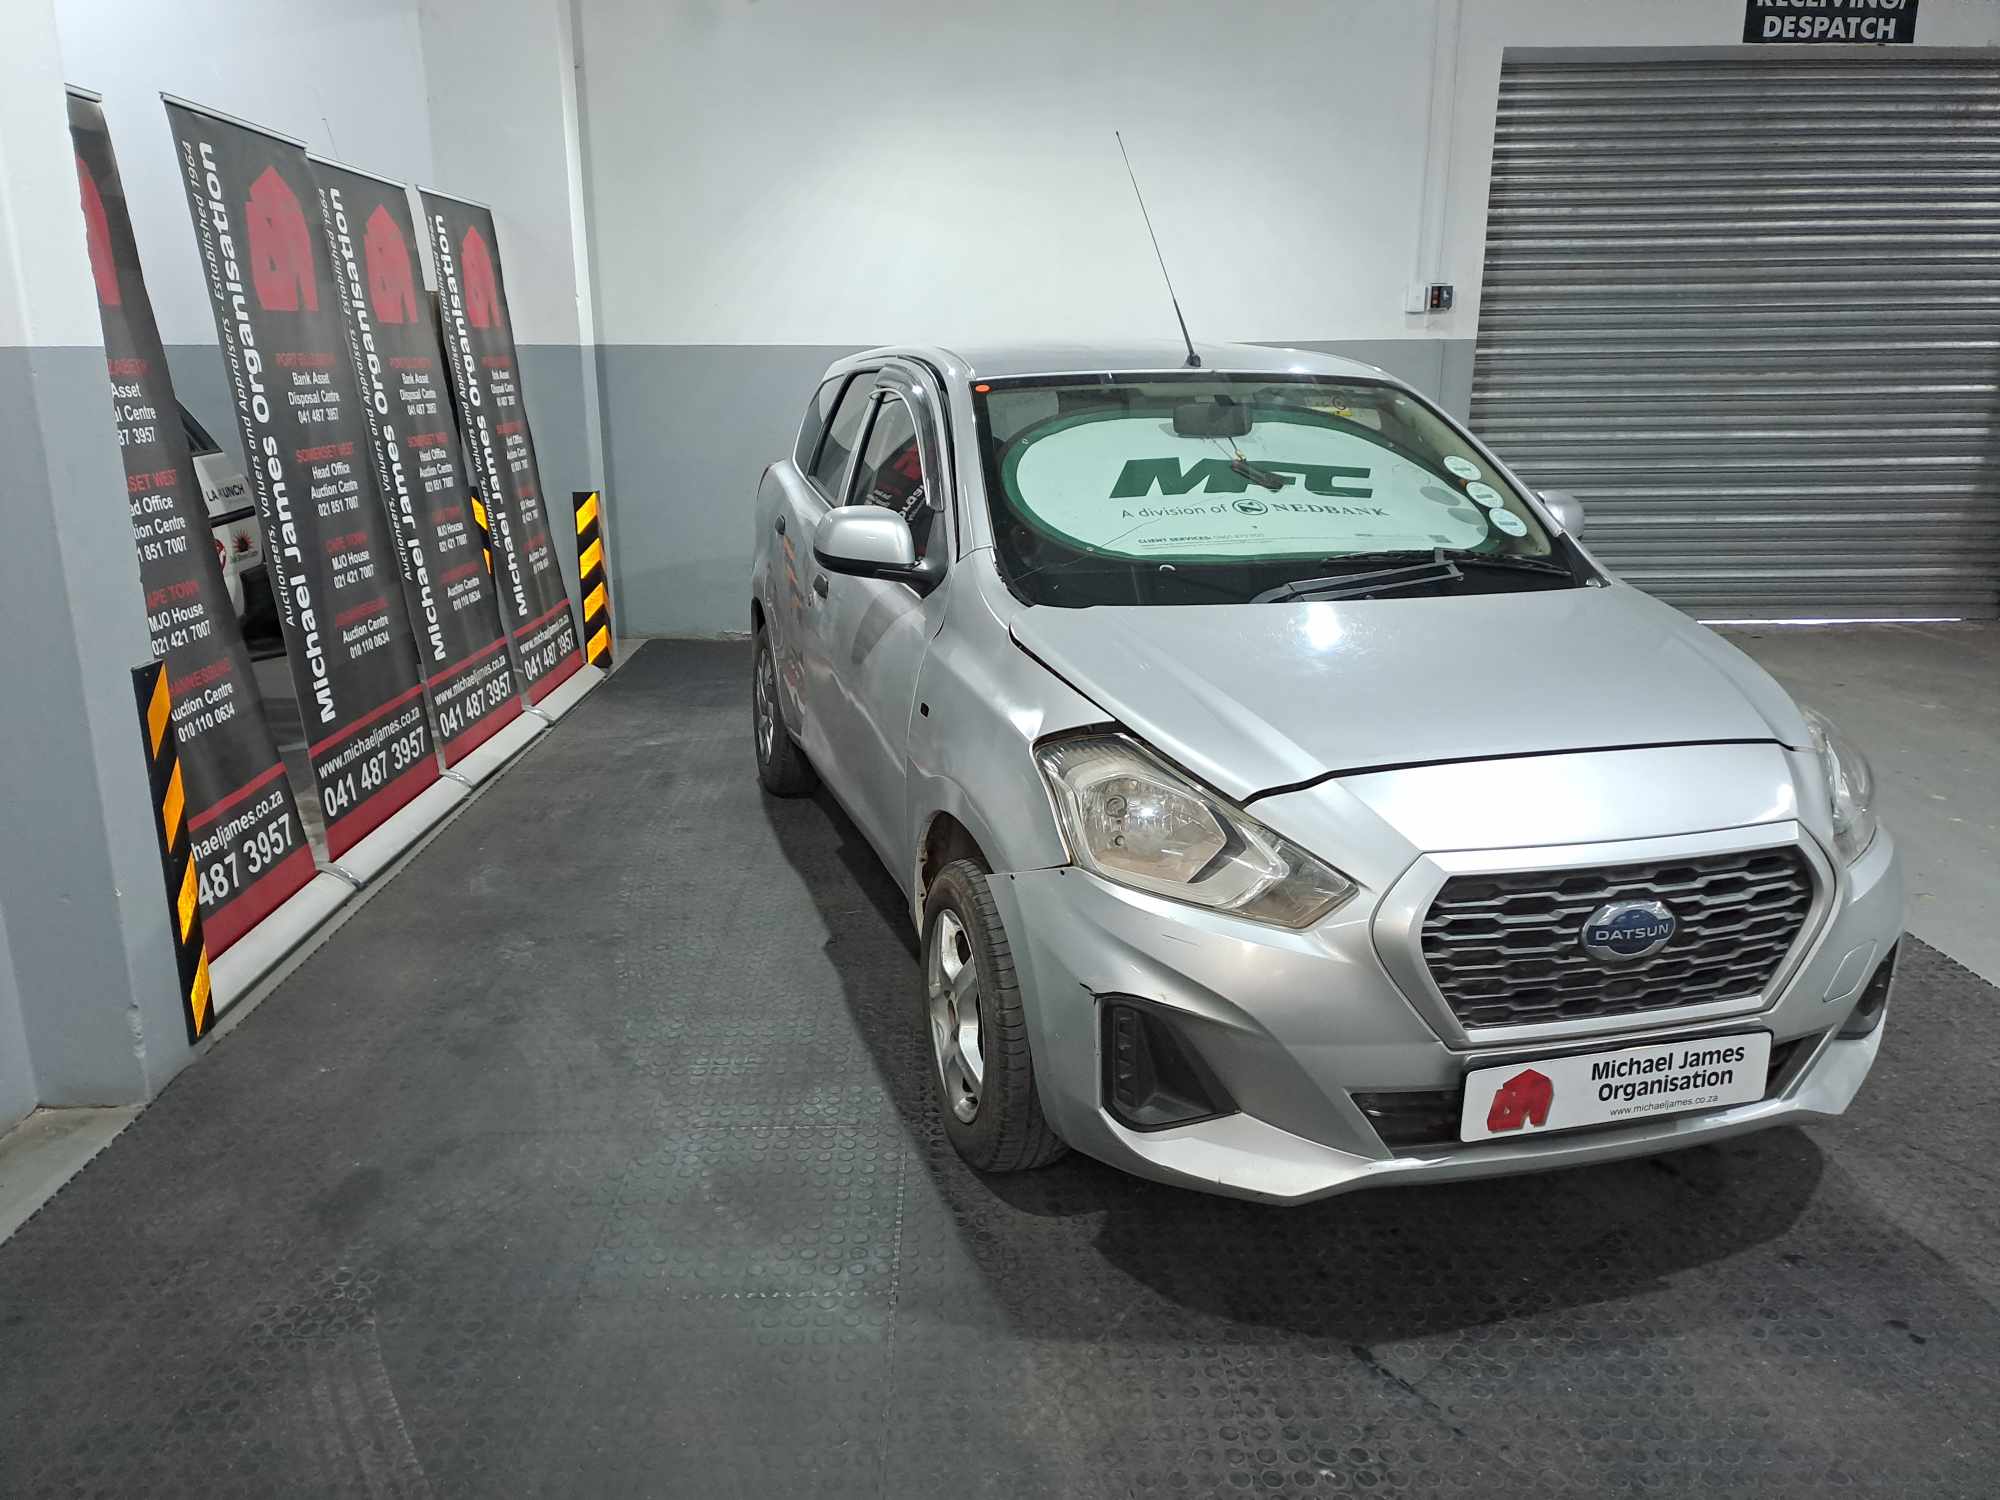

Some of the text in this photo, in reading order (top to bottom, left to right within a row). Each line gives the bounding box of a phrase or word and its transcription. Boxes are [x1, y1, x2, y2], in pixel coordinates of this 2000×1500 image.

[1763, 15, 1897, 39] DESPATCH
[182, 140, 200, 188] 1964
[192, 192, 224, 301] Established
[330, 188, 388, 415] Organisation
[435, 215, 480, 407] Organisation
[223, 318, 249, 412] Appraisers
[292, 371, 312, 386] Bank
[111, 382, 142, 398] Asset
[287, 389, 320, 407] Disposal
[123, 404, 157, 421] Centre
[132, 426, 155, 444] 3957
[199, 142, 336, 724] Michael James Organisation
[242, 415, 256, 449] and
[311, 464, 331, 480] Head
[383, 425, 416, 529] James
[477, 416, 503, 505] James
[252, 455, 271, 518] Valuers
[311, 483, 338, 499] Auction
[142, 495, 174, 513] Office
[1122, 503, 1391, 519] A division of NEDBANK
[154, 515, 186, 534] Centre
[143, 541, 164, 561] 851
[164, 535, 187, 555] 7007
[496, 512, 527, 616] Michael
[407, 539, 446, 660] Michael
[148, 603, 204, 633] MJO House
[342, 624, 368, 644] Auction
[151, 620, 212, 656] 021 421 7007
[524, 652, 543, 681] 041
[543, 641, 557, 668] 487
[203, 682, 234, 705] Centre
[440, 671, 512, 738] 041 487 3957
[178, 701, 236, 743] 010 110 0634
[318, 706, 420, 779] www.michaeljames.co.za
[324, 725, 425, 817] 041 487 3957
[198, 812, 292, 905] 487 3957
[1595, 923, 1670, 941] DATSUN
[1591, 1046, 1745, 1081] Michael James
[1598, 1067, 1734, 1101] Organisation
[1610, 1094, 1719, 1117] www.michaeljames.co.za
